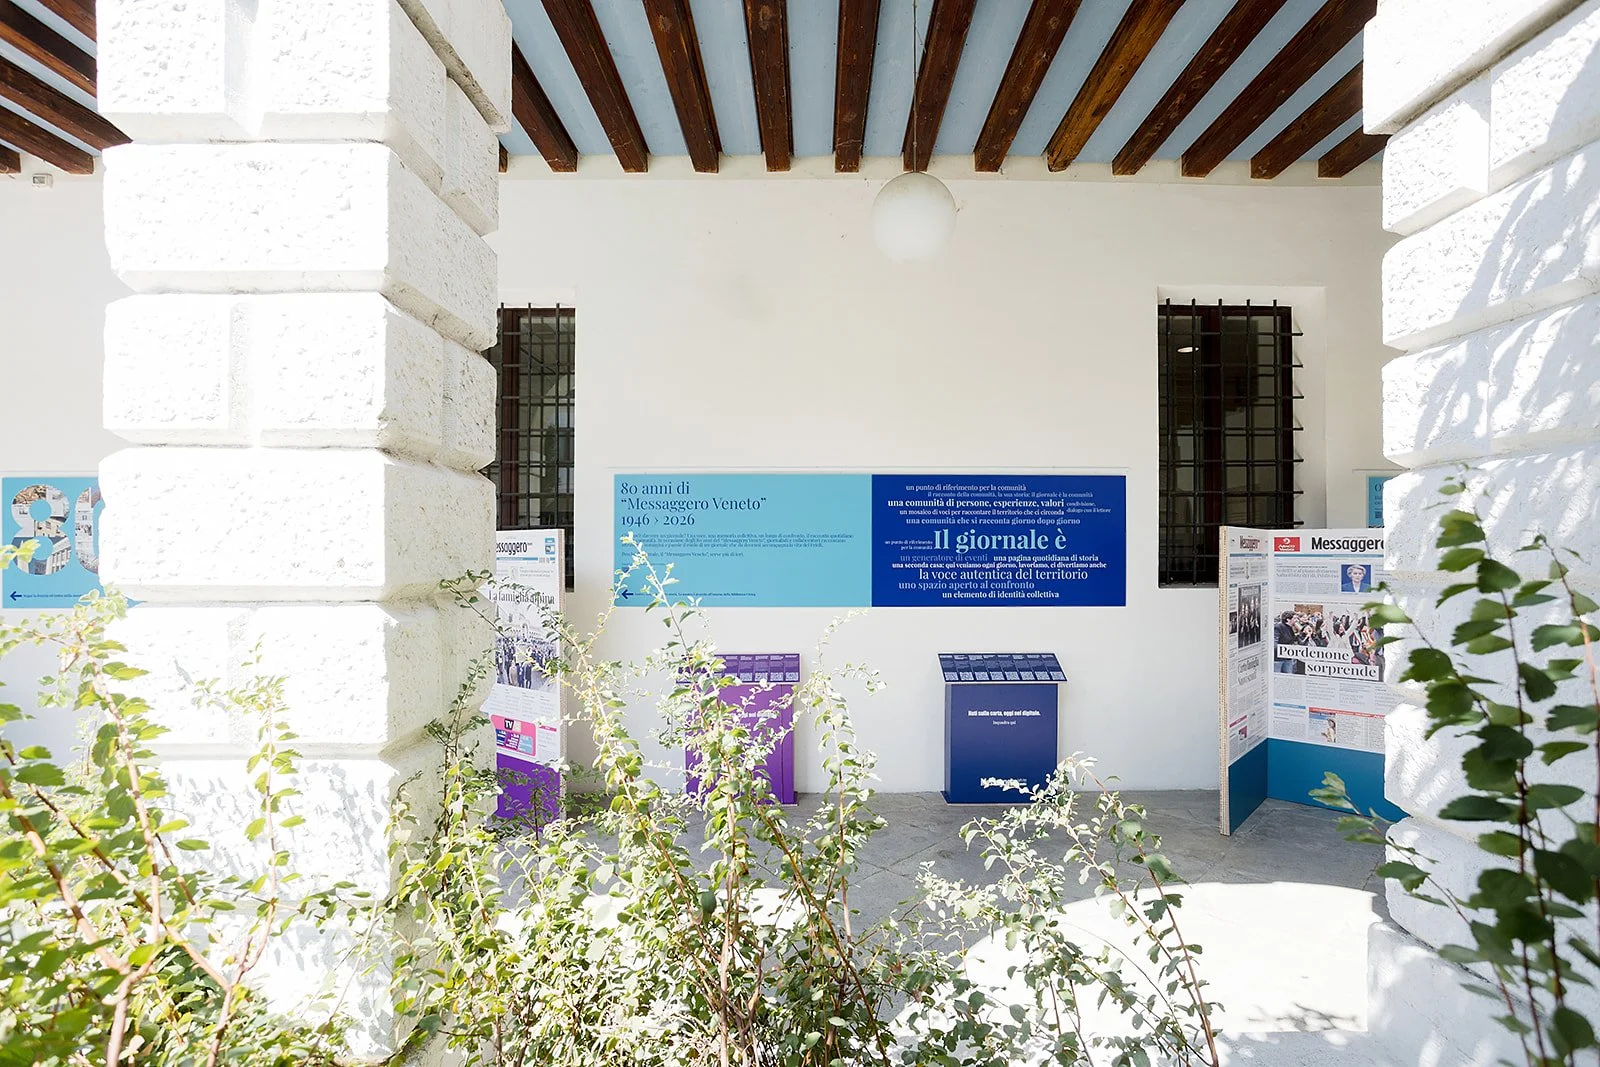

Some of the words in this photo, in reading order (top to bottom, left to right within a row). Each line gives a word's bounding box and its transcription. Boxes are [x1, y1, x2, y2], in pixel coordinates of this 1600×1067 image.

[621, 482, 638, 494] 80
[642, 481, 672, 495] anni
[677, 481, 689, 495] di
[621, 498, 709, 512] “Messaggero
[713, 497, 766, 510] Veneto”
[905, 498, 944, 507] comunità
[946, 498, 954, 507] di
[956, 500, 991, 508] persone,
[993, 498, 1039, 508] esperienze,
[1041, 499, 1064, 507] valori
[622, 513, 650, 527] 1946
[664, 513, 695, 526] 2026
[921, 516, 956, 524] comunità
[1011, 517, 1036, 525] giorno
[1037, 517, 1055, 526] dopo
[1056, 517, 1081, 526] giorno
[934, 529, 950, 550] Il
[956, 529, 1048, 554] giornale
[1055, 528, 1066, 549] è
[496, 542, 528, 556] essaggero
[912, 554, 954, 563] generatore
[1008, 554, 1031, 562] pagina
[1032, 554, 1069, 562] quotidiana
[919, 568, 929, 580] la
[932, 570, 957, 580] voce
[960, 569, 1012, 580] autentica
[1015, 568, 1032, 580] del
[1036, 568, 1088, 580] territorio
[918, 580, 947, 590] spazio
[949, 581, 978, 590] aperto
[980, 580, 988, 589] al
[990, 580, 1035, 589] confronto
[997, 590, 1025, 598] identità
[1279, 645, 1349, 660] Pordenone
[1306, 664, 1377, 678] sorprende
